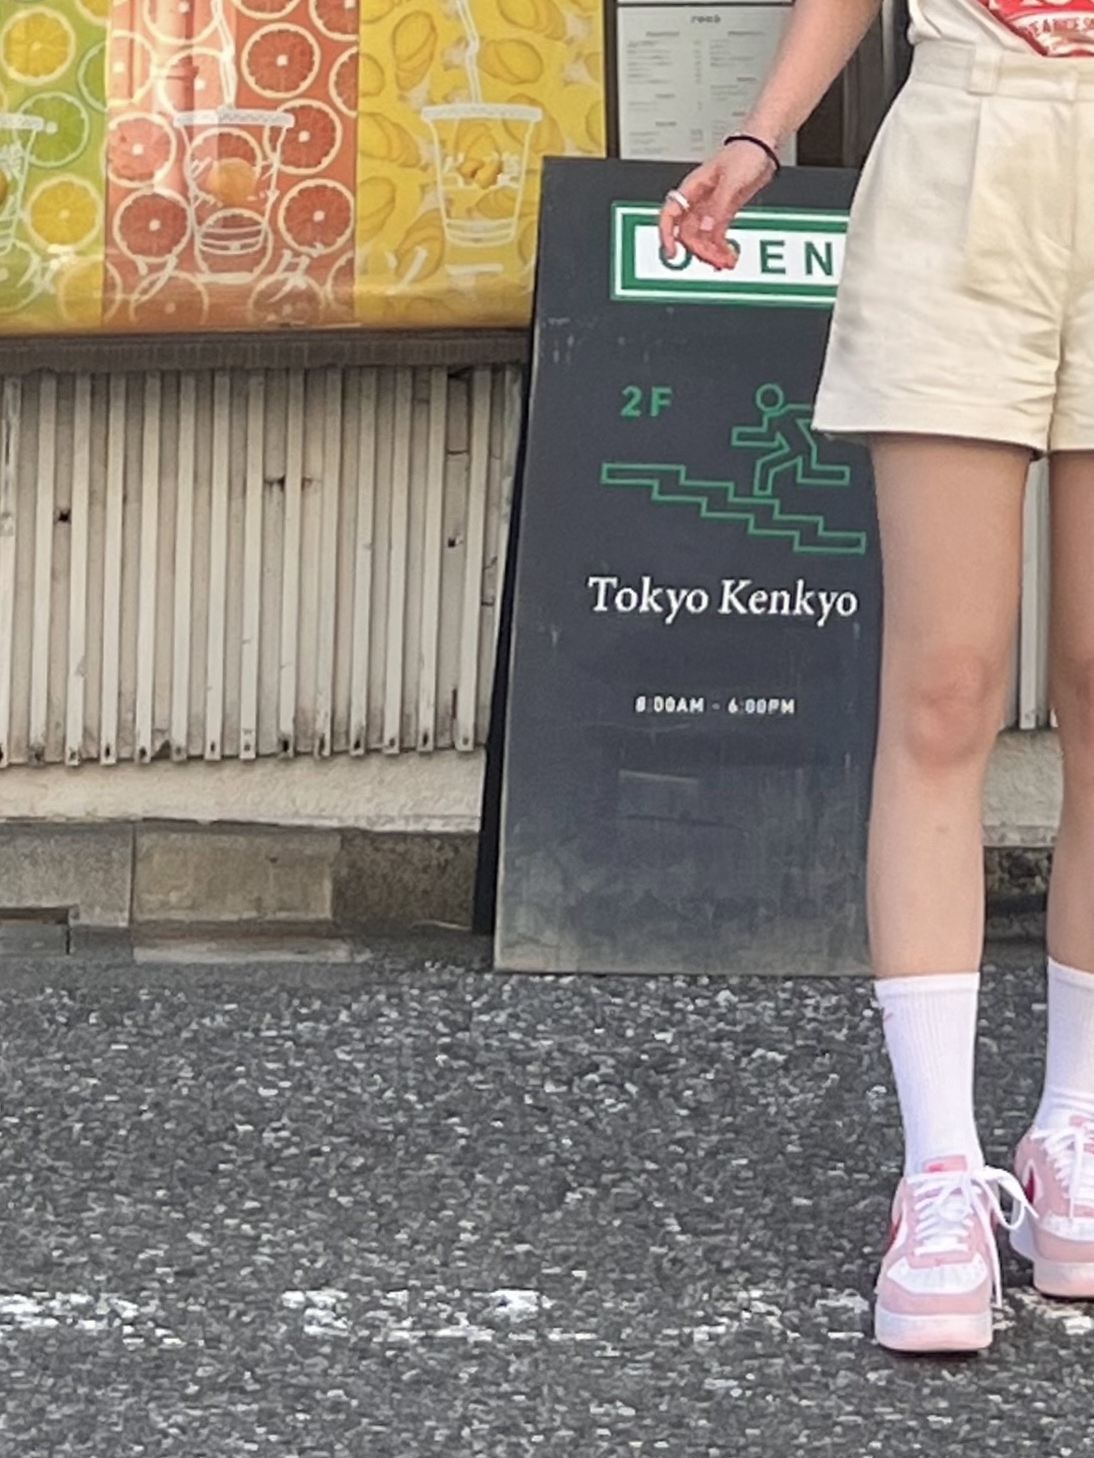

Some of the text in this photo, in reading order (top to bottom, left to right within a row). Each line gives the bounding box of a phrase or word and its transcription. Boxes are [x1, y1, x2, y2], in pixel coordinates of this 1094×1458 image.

[620, 385, 675, 419] 2F
[588, 576, 859, 628] Tokyo Kenkyo
